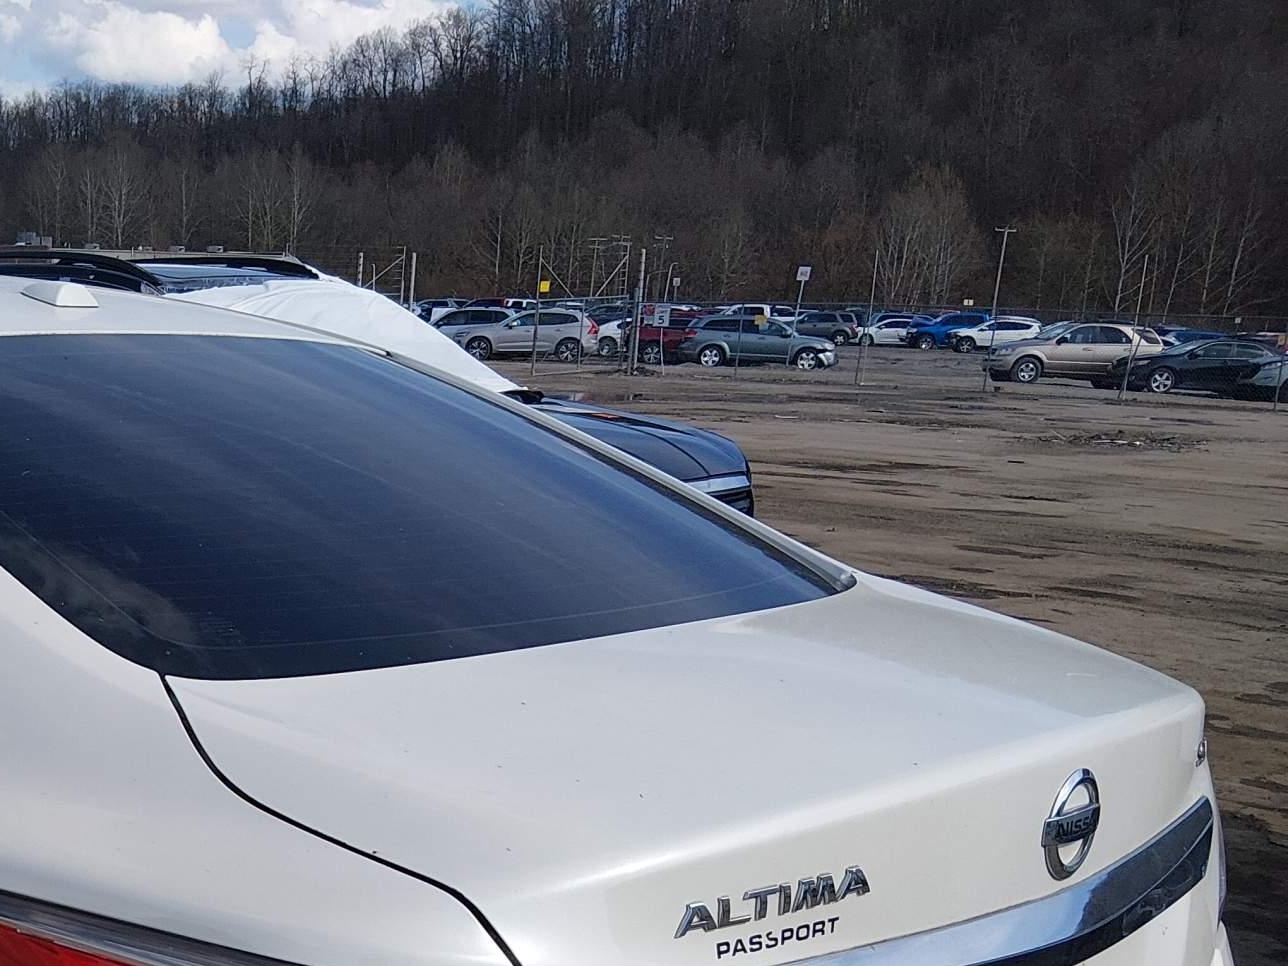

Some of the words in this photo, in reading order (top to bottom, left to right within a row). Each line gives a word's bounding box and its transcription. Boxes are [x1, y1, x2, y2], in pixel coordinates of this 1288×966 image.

[657, 315, 665, 325] 5
[673, 865, 871, 939] ALTIMA
[716, 916, 840, 960] PASSPORT
